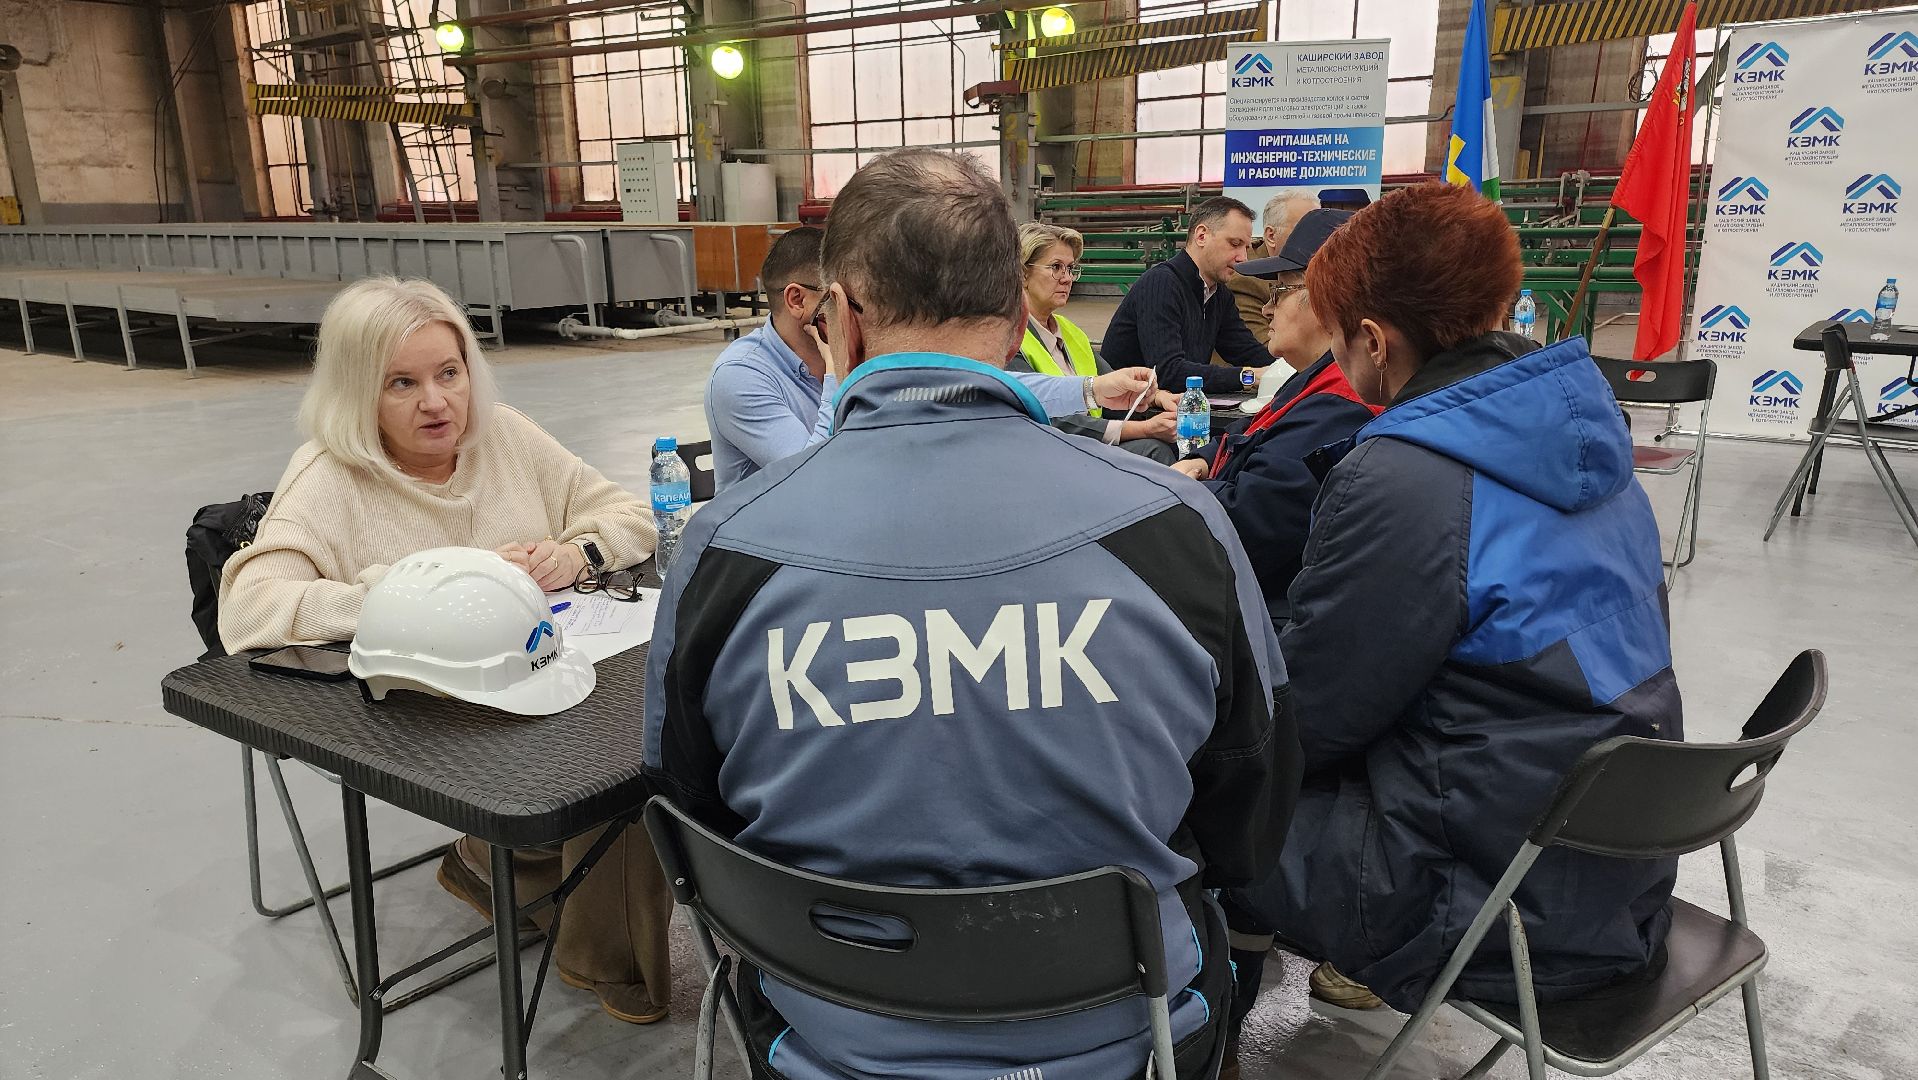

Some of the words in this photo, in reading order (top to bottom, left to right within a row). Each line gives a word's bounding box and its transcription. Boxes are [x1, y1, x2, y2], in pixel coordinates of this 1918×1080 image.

[1297, 51, 1351, 62] КАШИРСКИЙ
[1354, 51, 1384, 61] ЗАВОД
[1864, 60, 1918, 75] КЗМК
[1231, 76, 1275, 88] КЗМК
[1733, 69, 1785, 83] КЗМК
[1258, 134, 1332, 147] ПРИГЛАШАЕМ
[1334, 133, 1349, 145] НА
[1786, 135, 1841, 148] КЗМК
[1230, 149, 1376, 164] ИНЖЕНЕРНО-ТЕХНИЧЕСКИЕ
[1238, 168, 1246, 179] И
[1248, 167, 1297, 179] РАБОЧИЕ
[1299, 165, 1367, 180] ДОЛЖНОСТИ
[1715, 204, 1766, 215] КЗМК
[1842, 201, 1898, 214] КЗМК
[1767, 269, 1820, 281] КЗМК
[1697, 330, 1747, 343] КЗМК
[1749, 394, 1800, 408] КЗМК
[767, 598, 1120, 730] КЗМК
